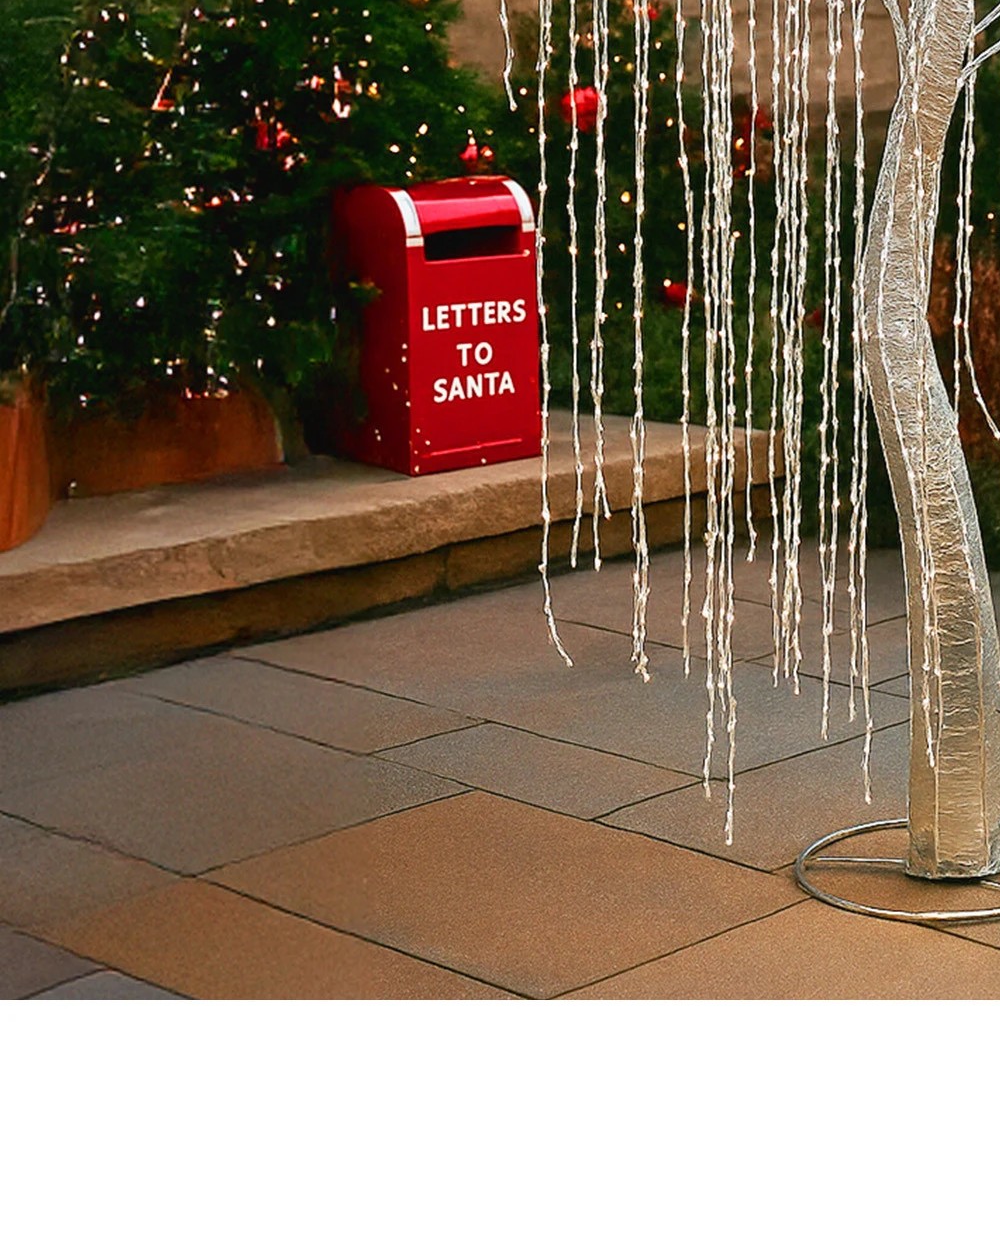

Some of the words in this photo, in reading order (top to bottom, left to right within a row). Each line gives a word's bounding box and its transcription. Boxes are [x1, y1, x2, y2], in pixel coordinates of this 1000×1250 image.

[422, 299, 526, 331] LETTERS
[456, 342, 493, 367] TO
[433, 371, 515, 403] SANTA
